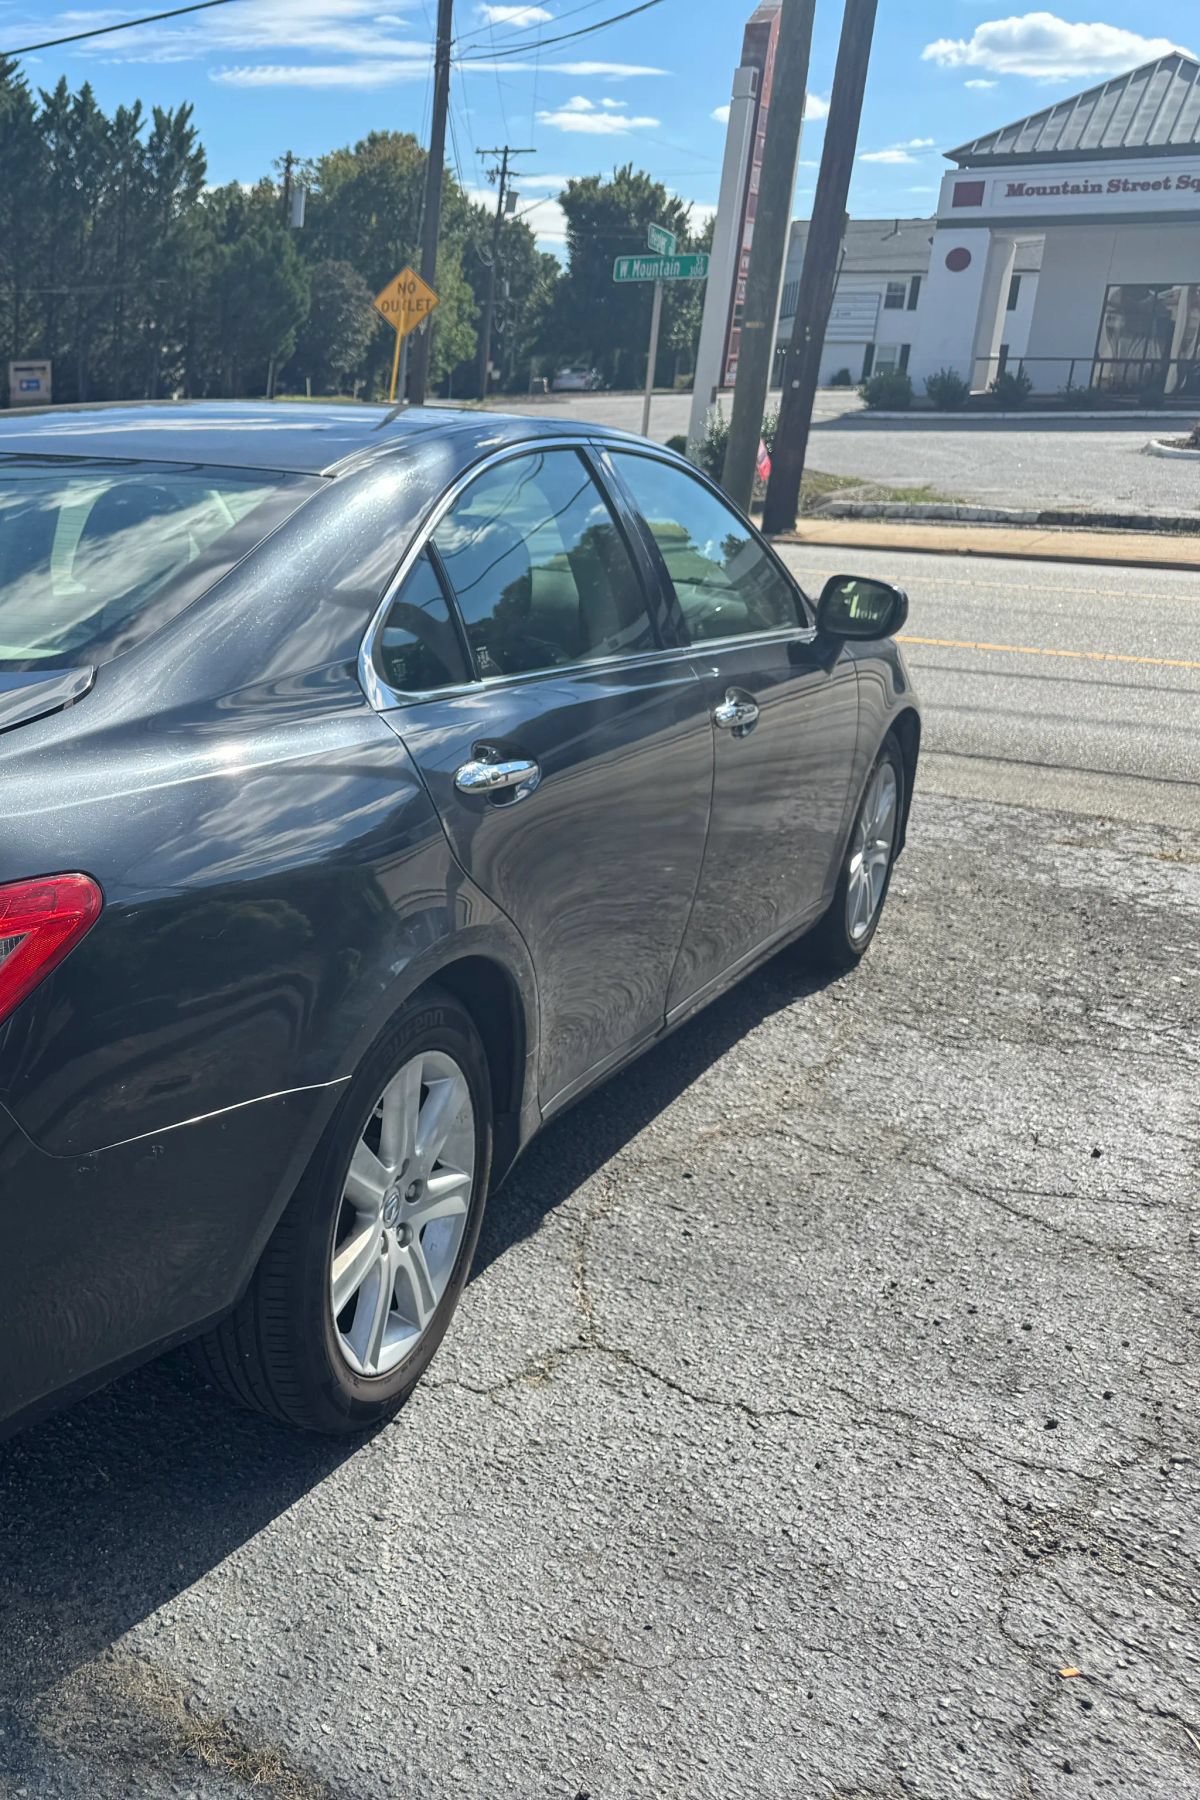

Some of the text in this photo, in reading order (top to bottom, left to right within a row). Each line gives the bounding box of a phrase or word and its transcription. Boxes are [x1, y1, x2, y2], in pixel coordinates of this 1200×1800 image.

[1005, 180, 1103, 198] Mountain
[1106, 175, 1172, 194] Street
[632, 258, 680, 278] Mountain
[397, 281, 416, 295] NO
